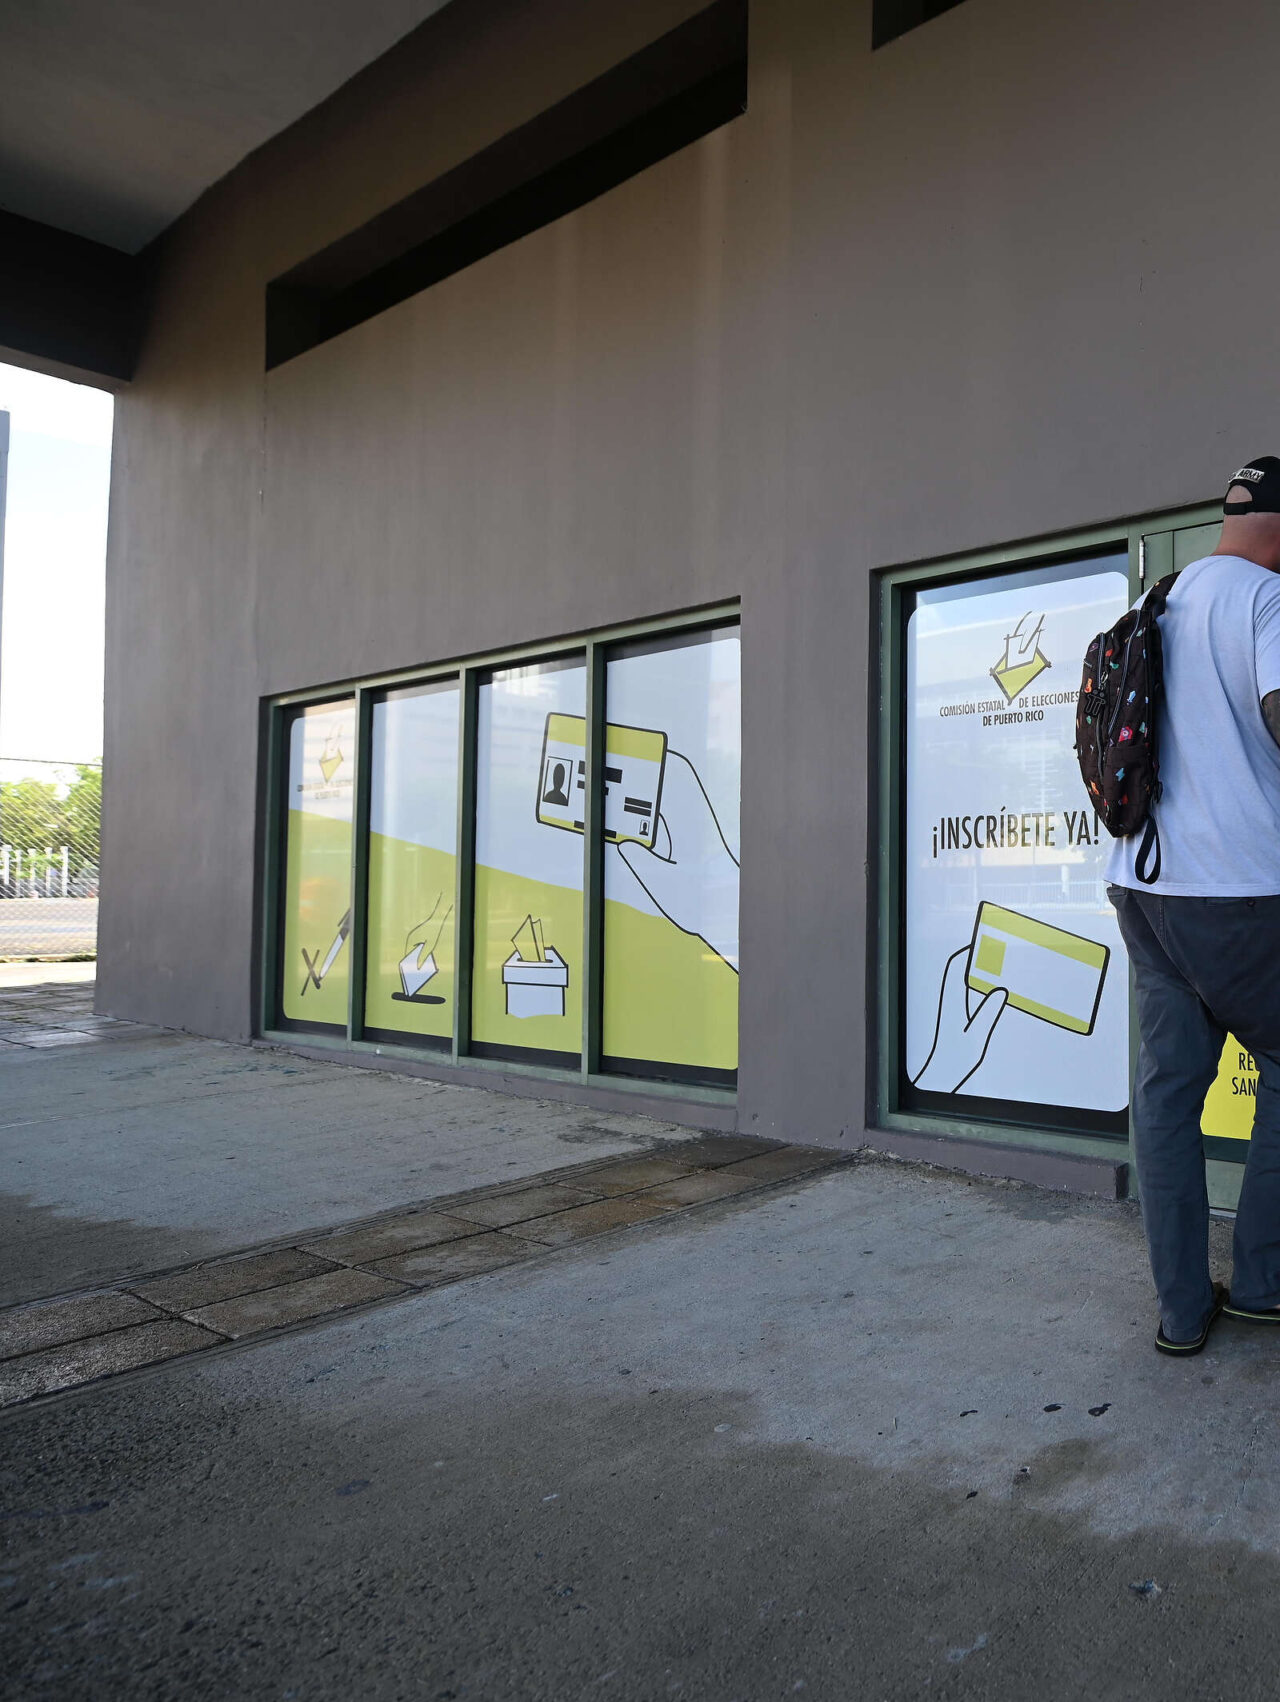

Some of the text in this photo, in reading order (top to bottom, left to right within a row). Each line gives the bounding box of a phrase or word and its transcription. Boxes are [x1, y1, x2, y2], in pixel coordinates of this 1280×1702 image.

[939, 690, 1079, 718] COMISIÓN ESTATAL DE ELECCIONES
[982, 709, 1045, 727] DE PUERTO RICO
[932, 805, 1099, 858] ¡INSCRÍBETE YA!
[1231, 1076, 1257, 1097] SAN
